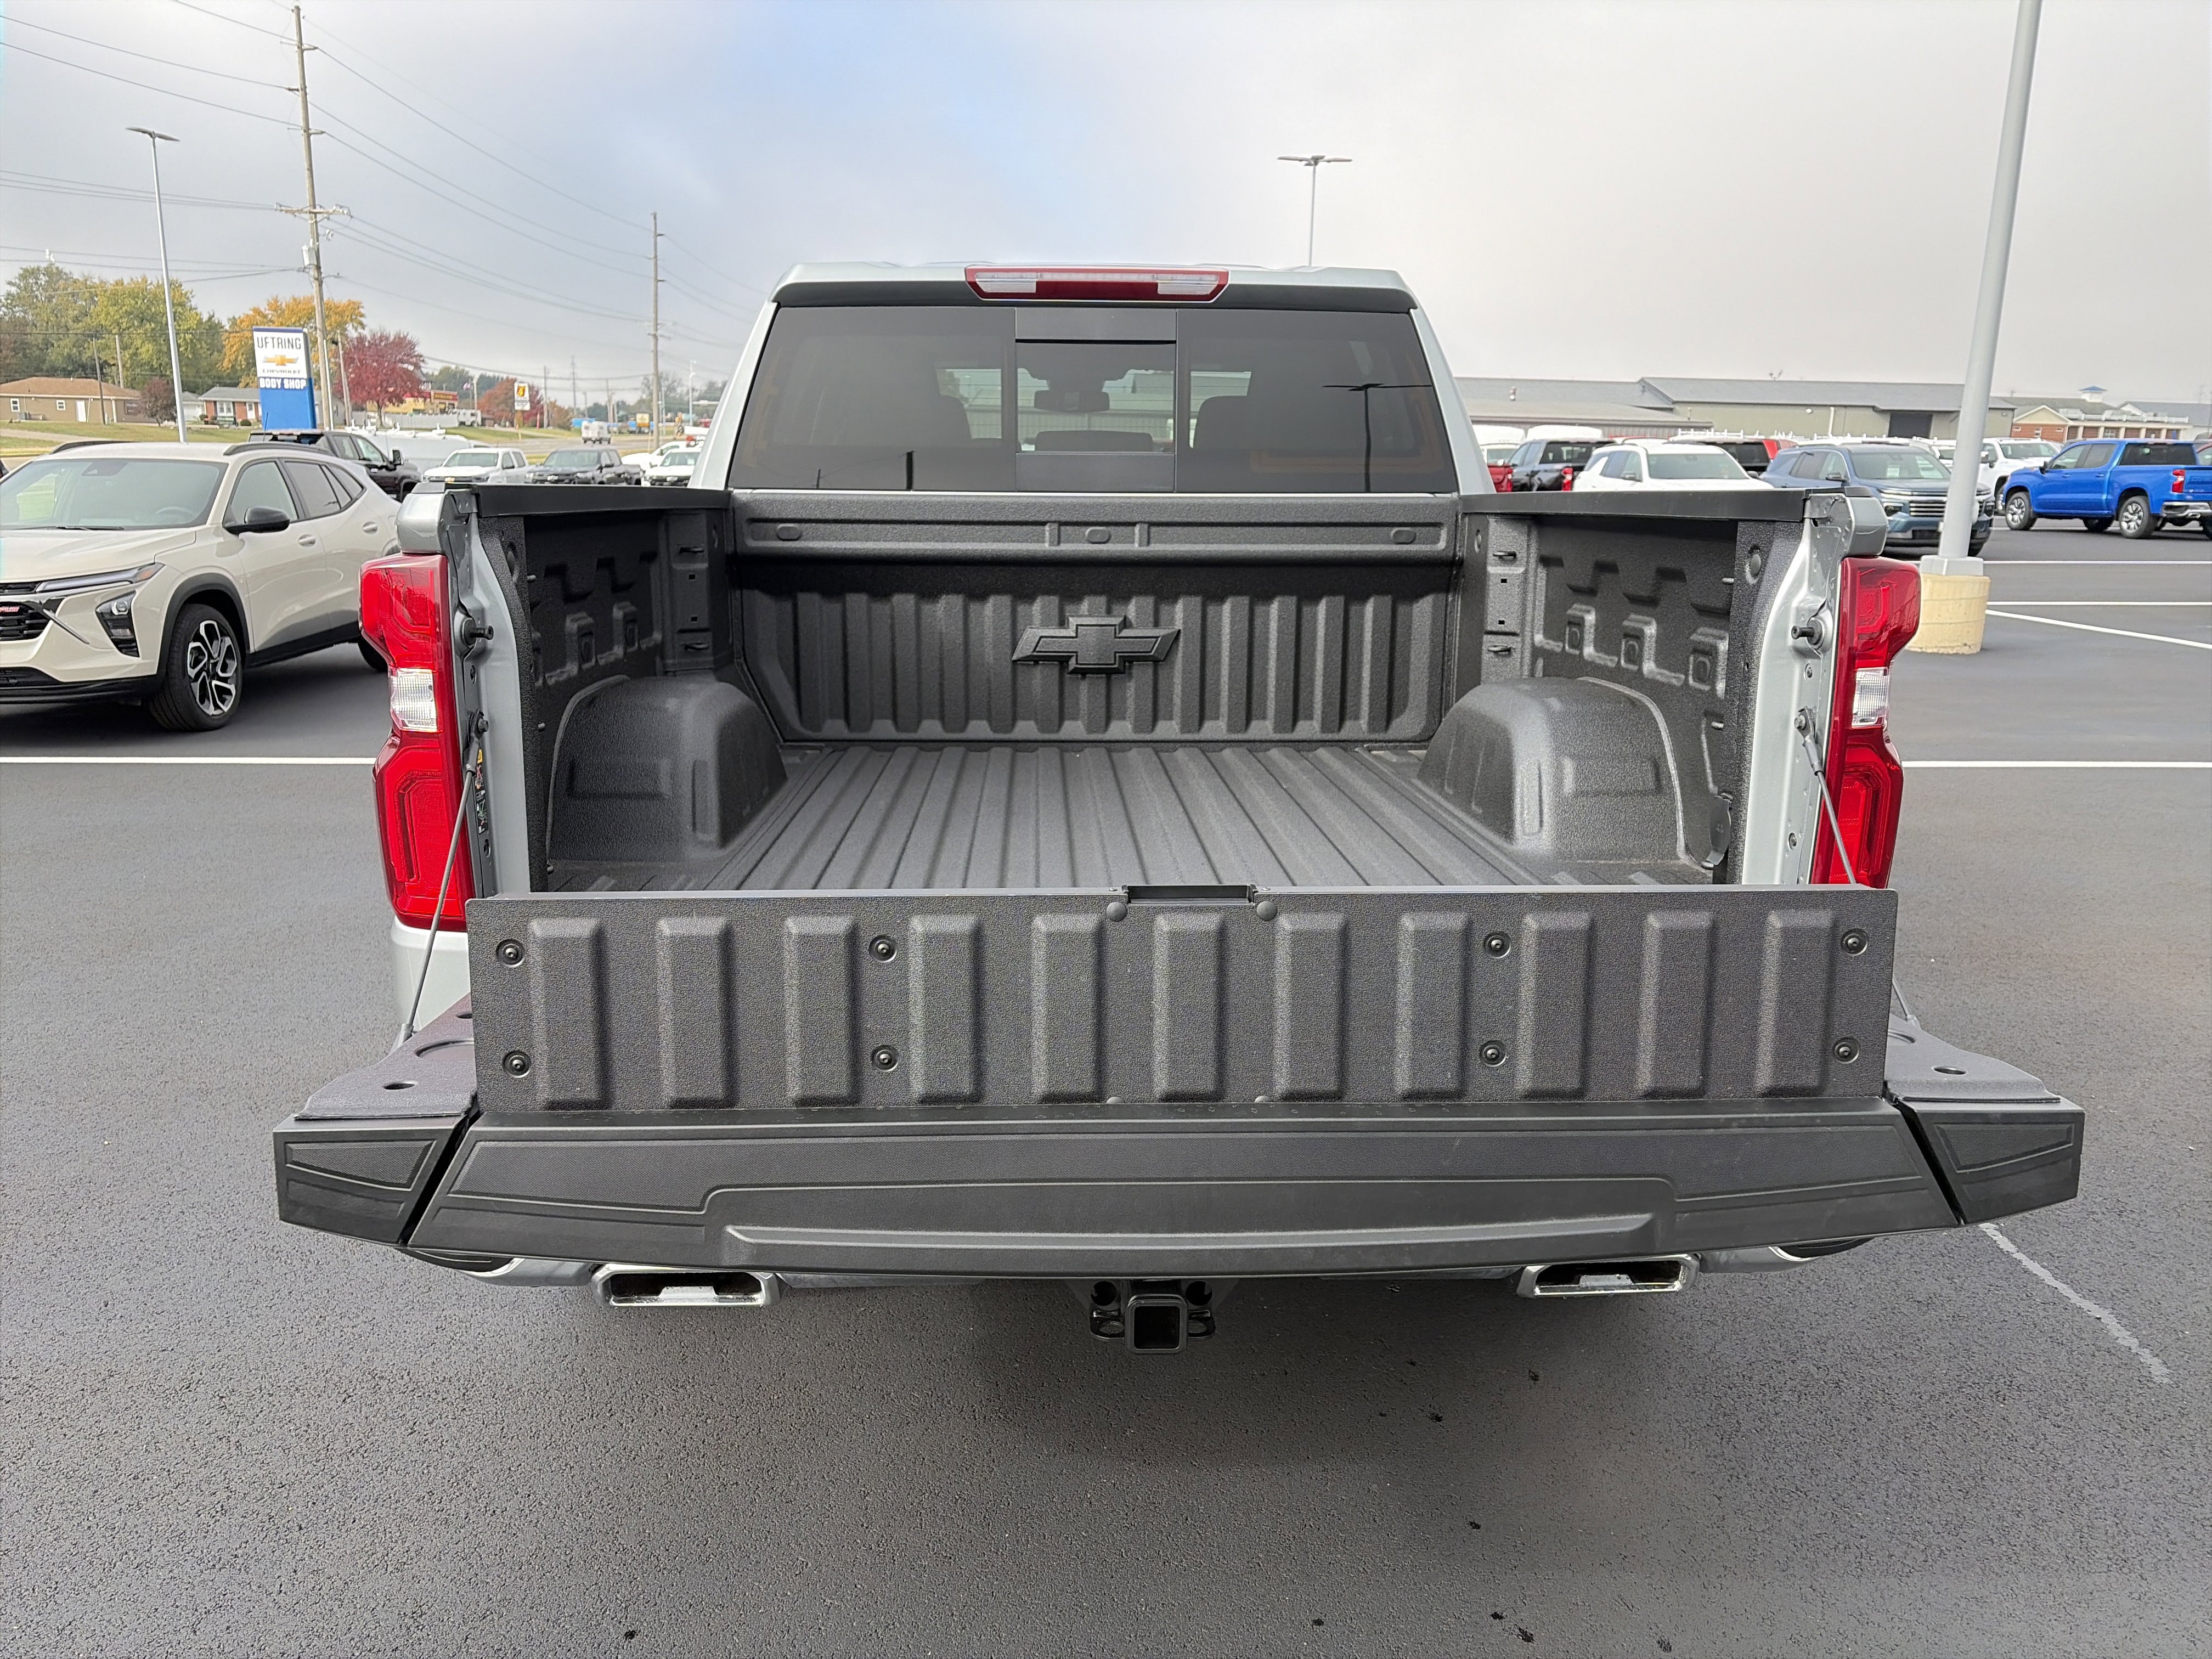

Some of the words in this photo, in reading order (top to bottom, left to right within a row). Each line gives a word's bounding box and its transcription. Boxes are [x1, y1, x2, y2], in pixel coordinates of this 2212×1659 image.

[257, 336, 301, 349] UFTRING
[259, 377, 281, 389] BODY
[283, 379, 306, 390] SHOP
